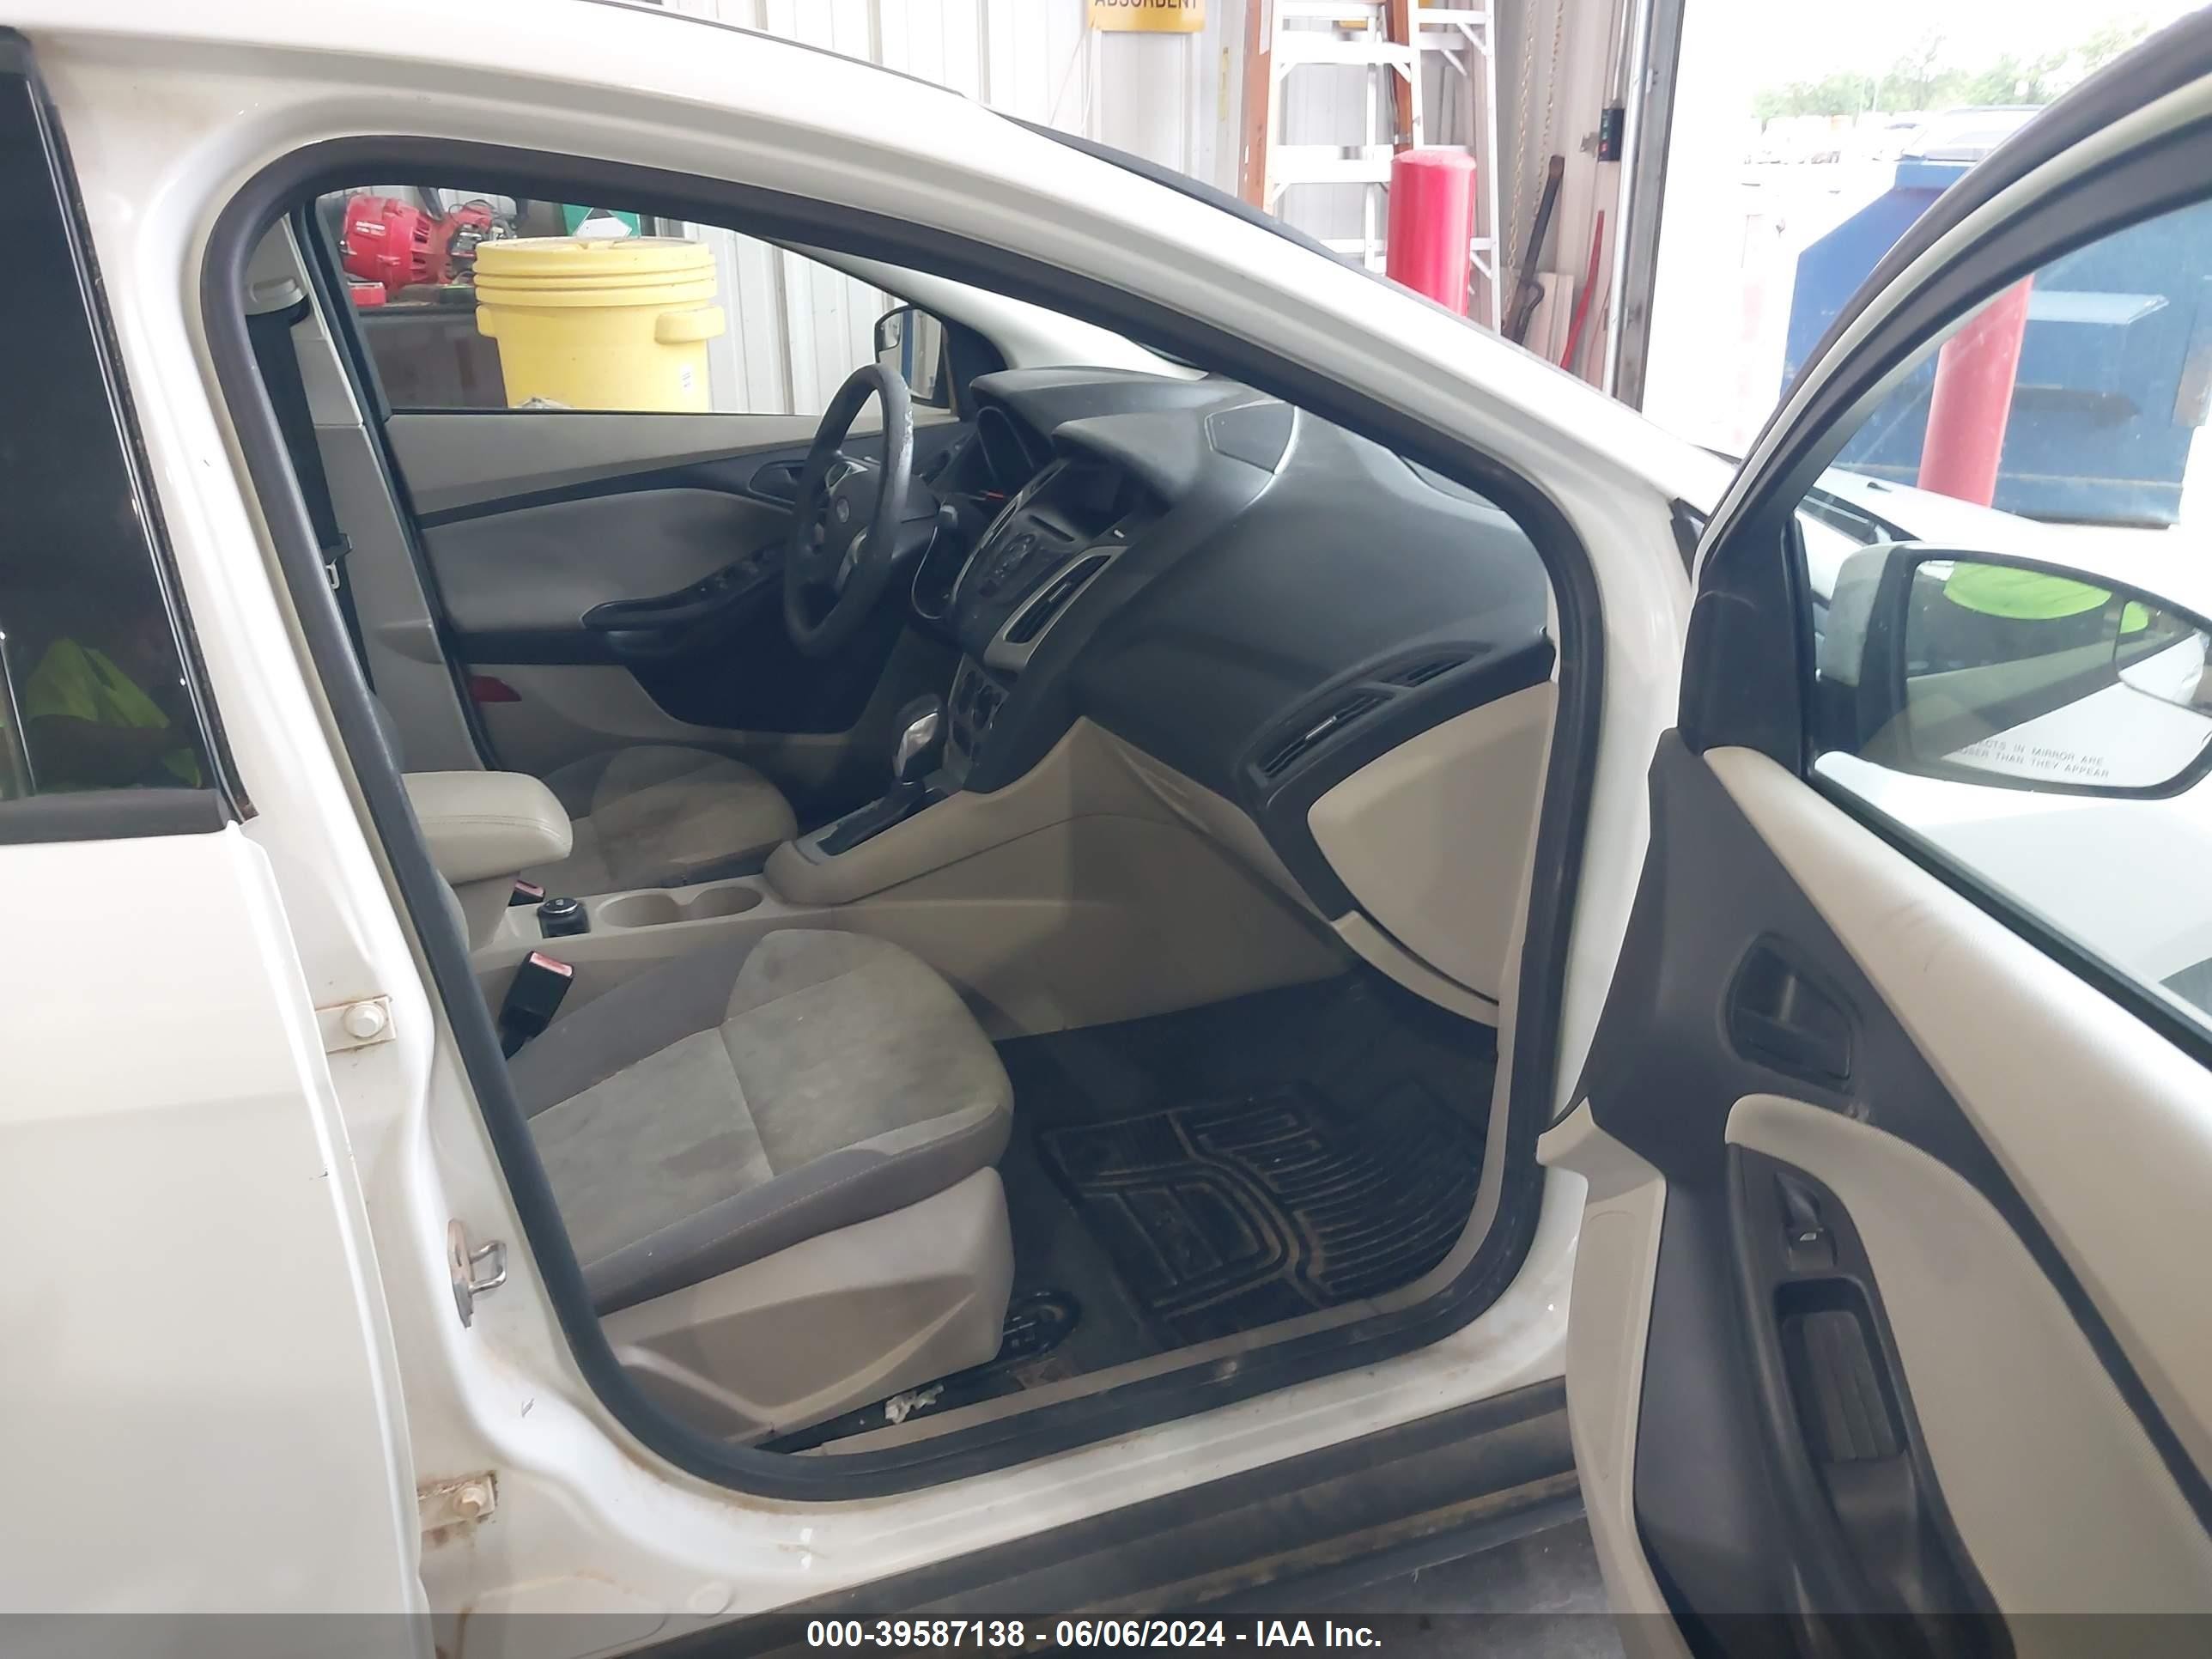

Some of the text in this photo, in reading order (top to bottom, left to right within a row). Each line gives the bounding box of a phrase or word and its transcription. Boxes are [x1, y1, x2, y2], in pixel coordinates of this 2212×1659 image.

[1996, 751, 2025, 764] THAN
[2032, 758, 2059, 770] THEY
[2063, 763, 2110, 778] APPEAR
[2013, 742, 2027, 754] IN
[2032, 746, 2075, 763] MIRROR
